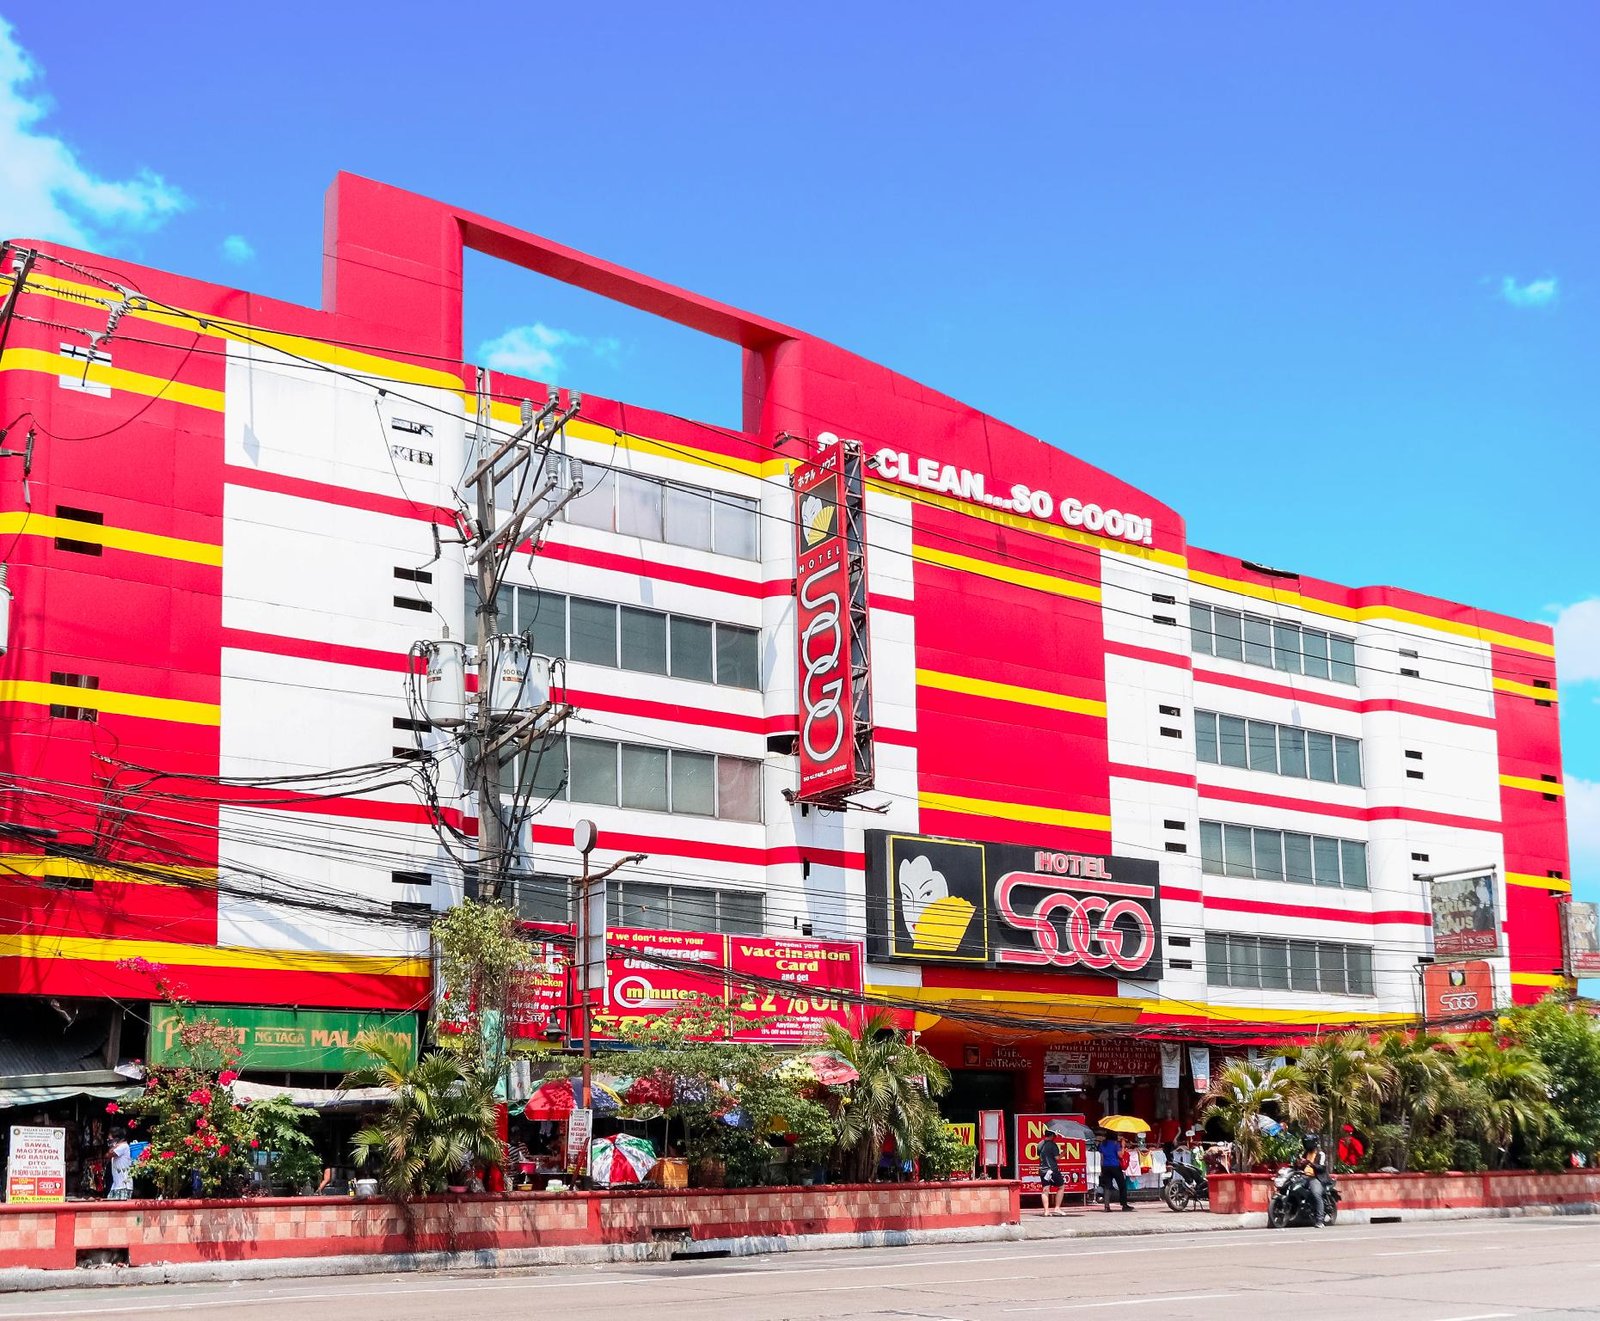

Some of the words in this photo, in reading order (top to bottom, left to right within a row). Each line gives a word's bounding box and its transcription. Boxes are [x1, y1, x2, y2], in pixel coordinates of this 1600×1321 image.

[1059, 498, 1153, 544] GOOD!
[799, 546, 840, 573] HOTEL
[800, 562, 844, 763] SOGO
[1034, 851, 1112, 879] HOTEL
[994, 870, 1156, 971] SOGO
[633, 933, 656, 942] don't
[740, 945, 851, 961] Vaccination
[775, 960, 819, 972] Card
[781, 972, 795, 980] and
[796, 973, 809, 982] get
[541, 990, 554, 998] any
[626, 987, 697, 1000] minutes
[540, 1002, 549, 1010] do
[1440, 992, 1478, 1010] SOGO
[255, 1031, 272, 1042] NG
[274, 1031, 305, 1043] TAGA
[985, 1058, 1032, 1068] ENTRANCE
[1127, 1061, 1151, 1070] OFF
[1025, 1142, 1080, 1160] OEN
